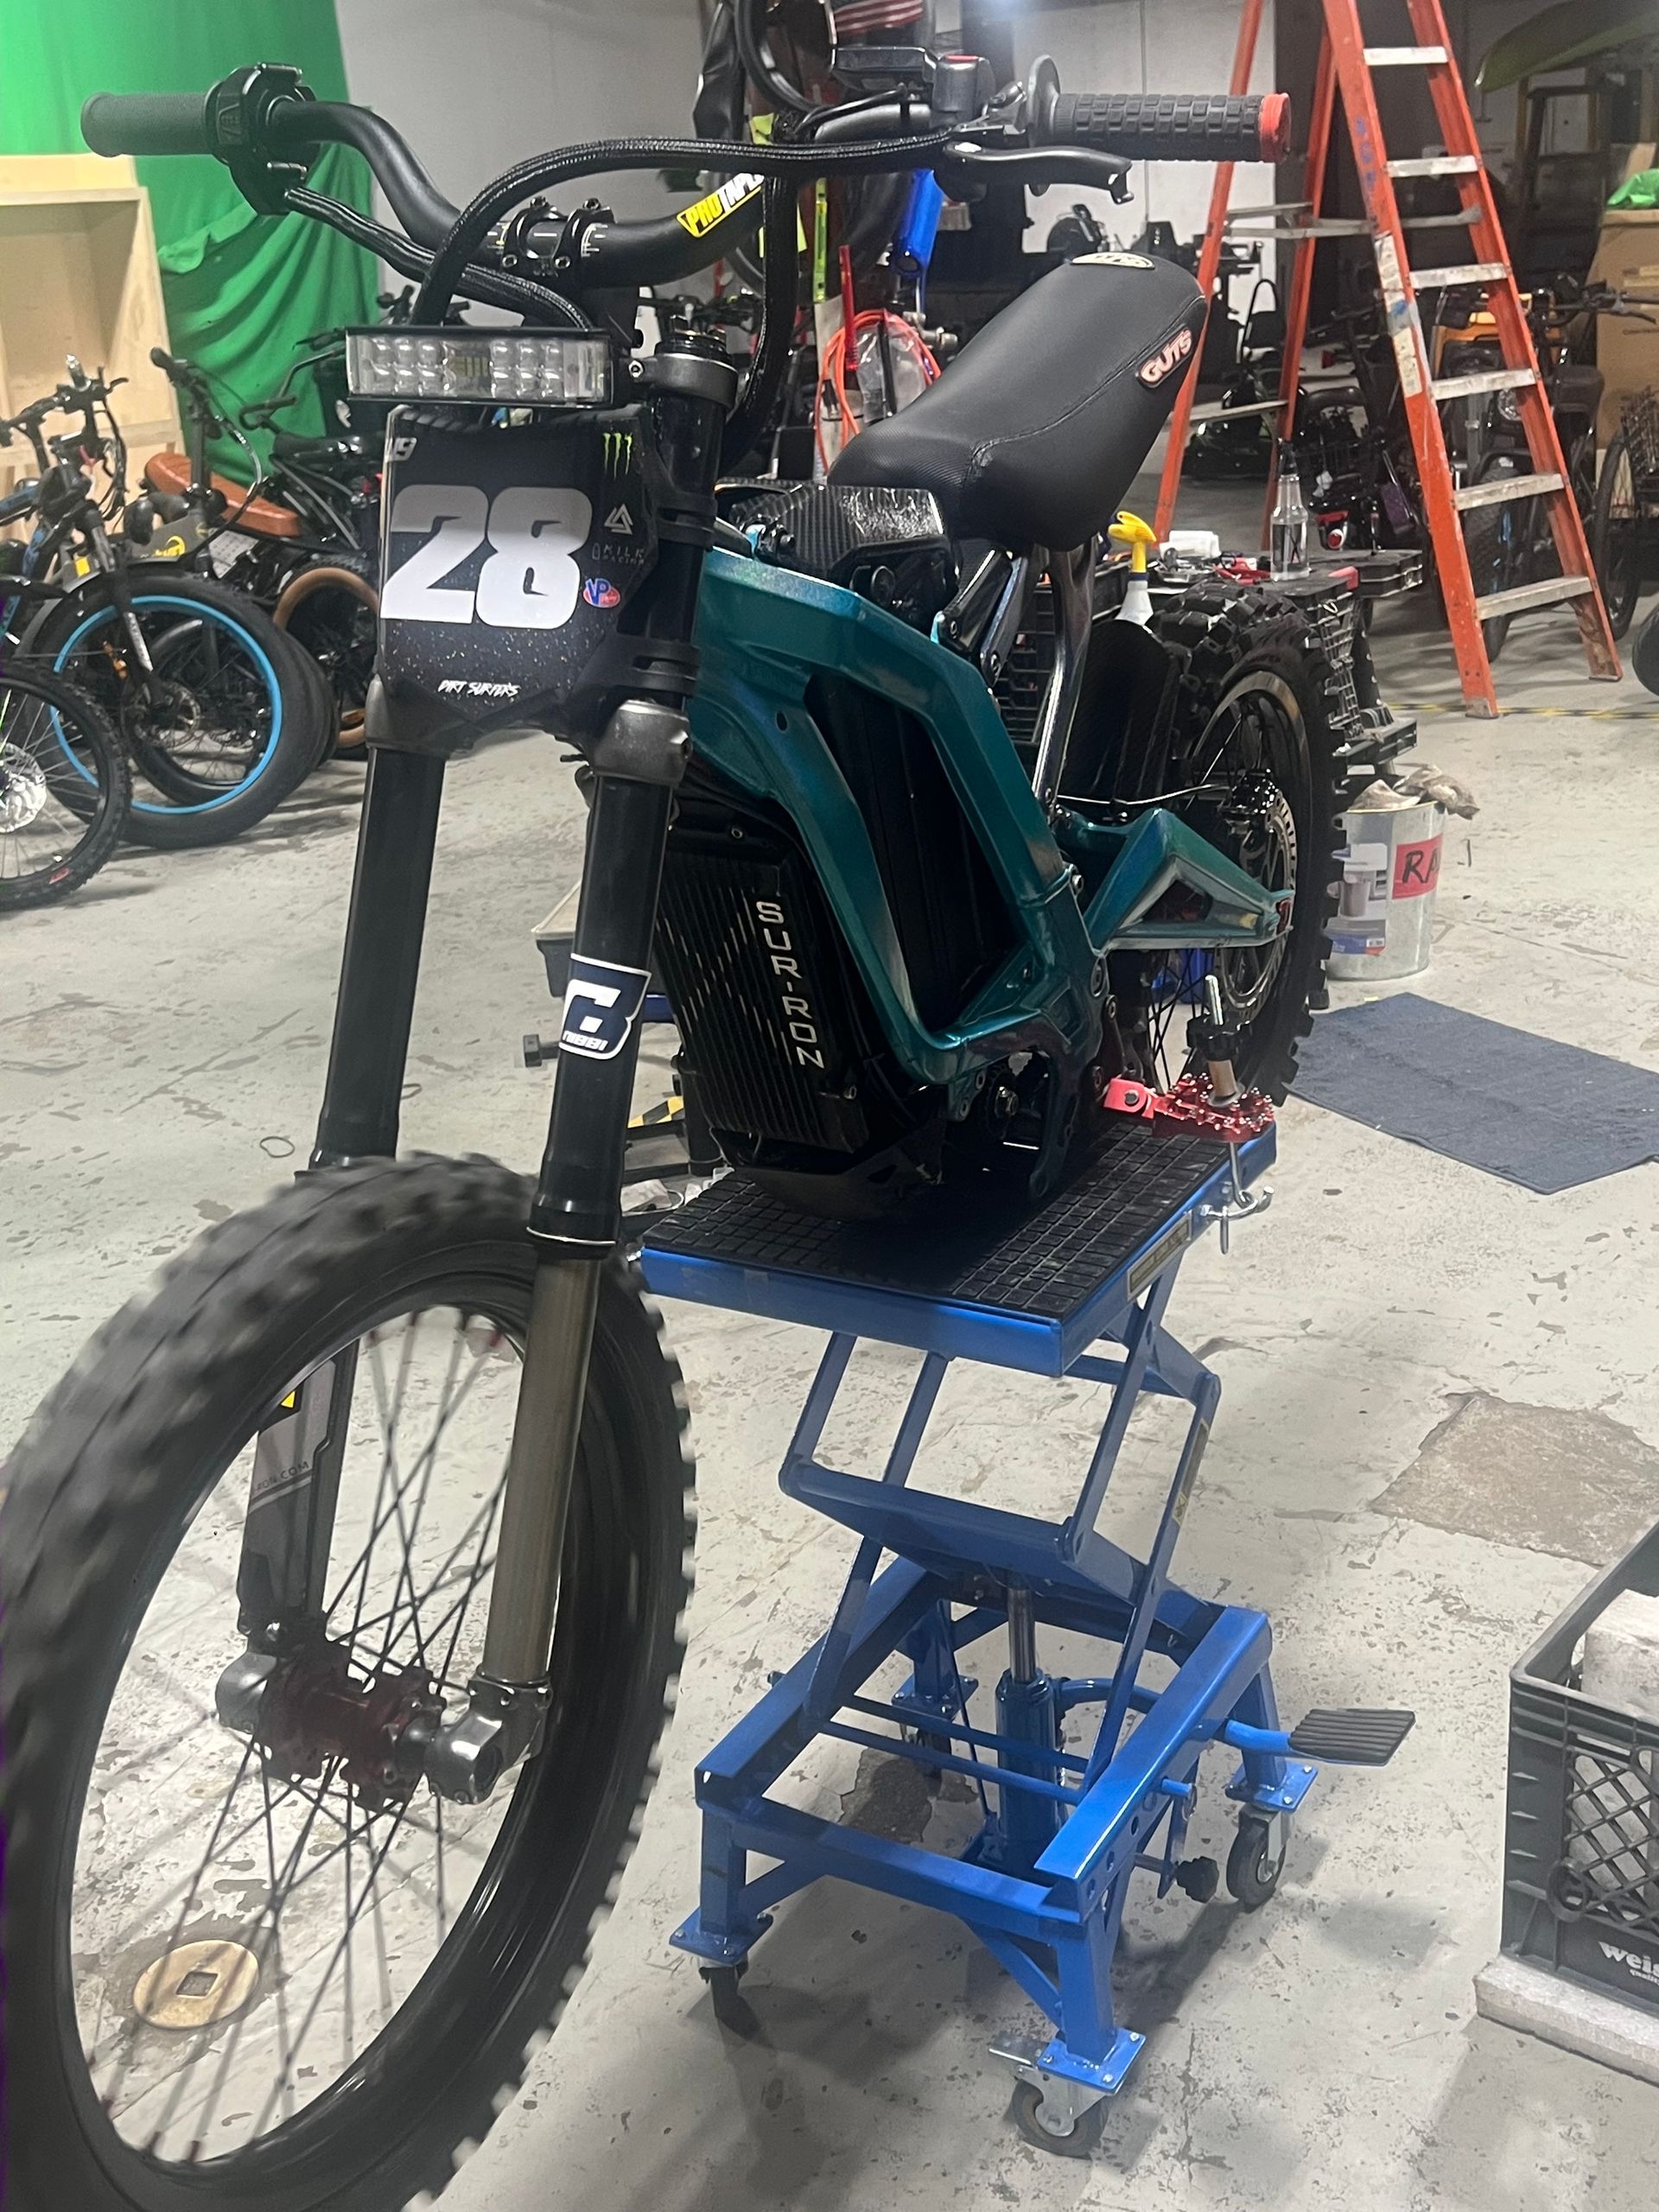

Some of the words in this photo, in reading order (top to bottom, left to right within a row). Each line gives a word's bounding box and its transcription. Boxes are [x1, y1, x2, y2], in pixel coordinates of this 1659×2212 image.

[1141, 328, 1192, 383] GUTS
[380, 484, 593, 629] 28
[585, 578, 611, 605] VP
[437, 679, 467, 694] DIRT
[756, 901, 824, 1069] SUR-RON
[562, 1030, 609, 1052] NIBBI
